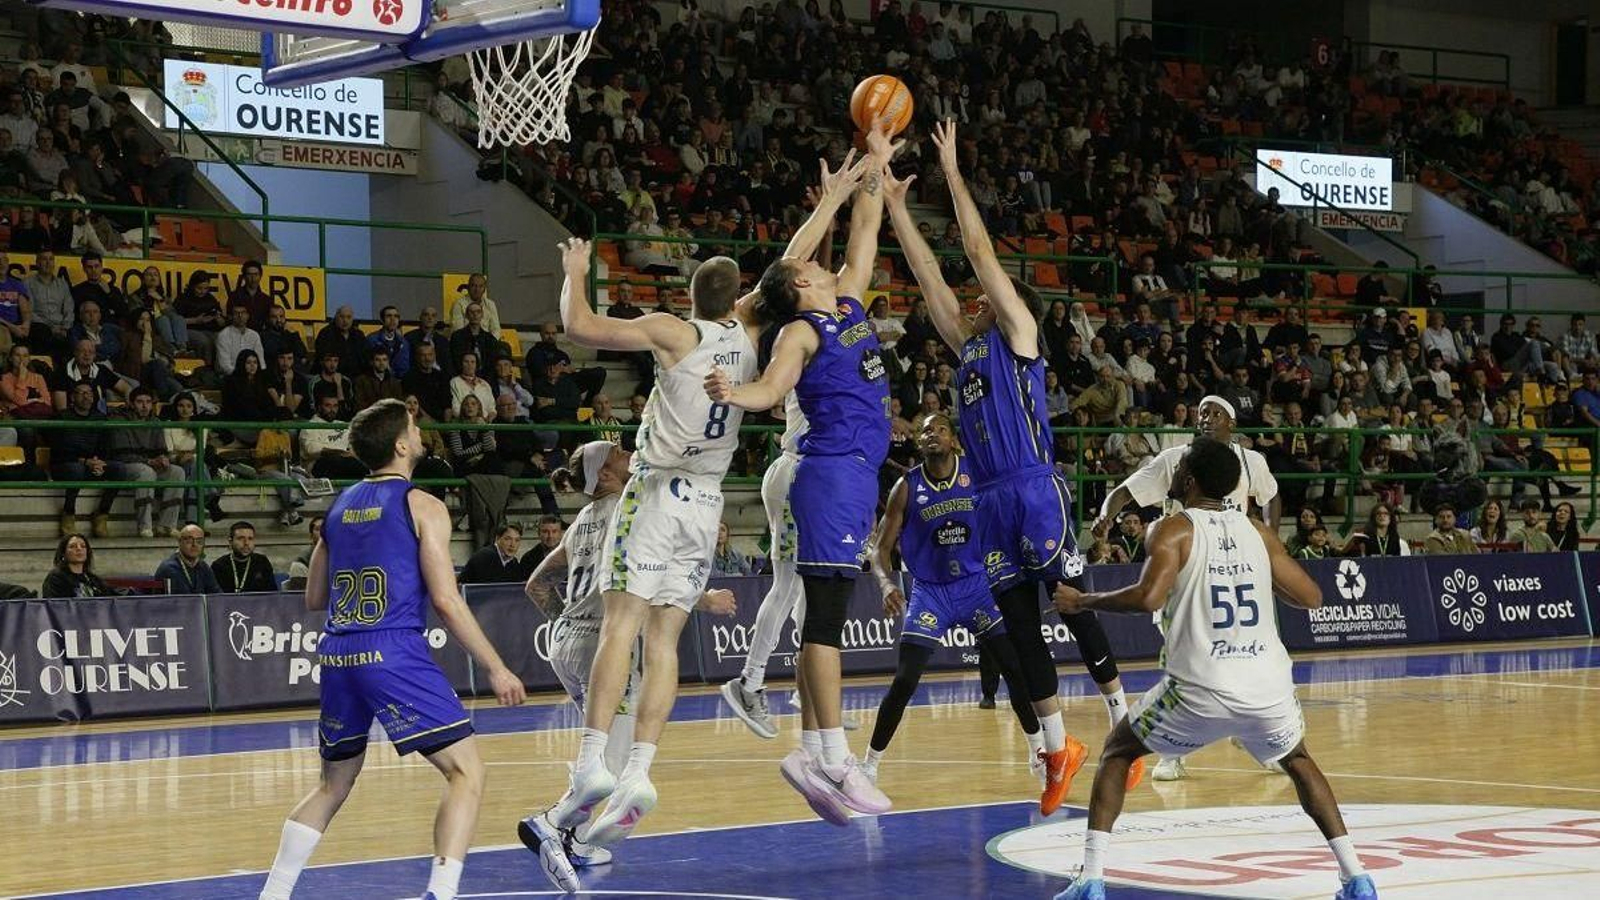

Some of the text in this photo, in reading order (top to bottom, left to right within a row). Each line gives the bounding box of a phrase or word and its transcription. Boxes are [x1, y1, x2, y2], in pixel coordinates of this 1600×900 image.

[1317, 44, 1328, 65] 6
[236, 74, 358, 103] Concello de
[237, 104, 380, 139] OURENSE
[282, 145, 406, 170] EMERXENCIA
[1301, 158, 1376, 179] Concello de
[1301, 183, 1389, 206] OURENSE
[1321, 212, 1399, 229] EMERXENCIA
[704, 402, 729, 439] 8
[949, 560, 961, 576] 3
[1493, 574, 1542, 592] viaxes
[332, 566, 387, 625] 28
[1210, 583, 1259, 629] 55
[1309, 603, 1405, 623] RECICLAJES VIDAL
[1498, 599, 1576, 622] low cost
[37, 627, 184, 660] CLIVET
[39, 661, 189, 696] OURENSE
